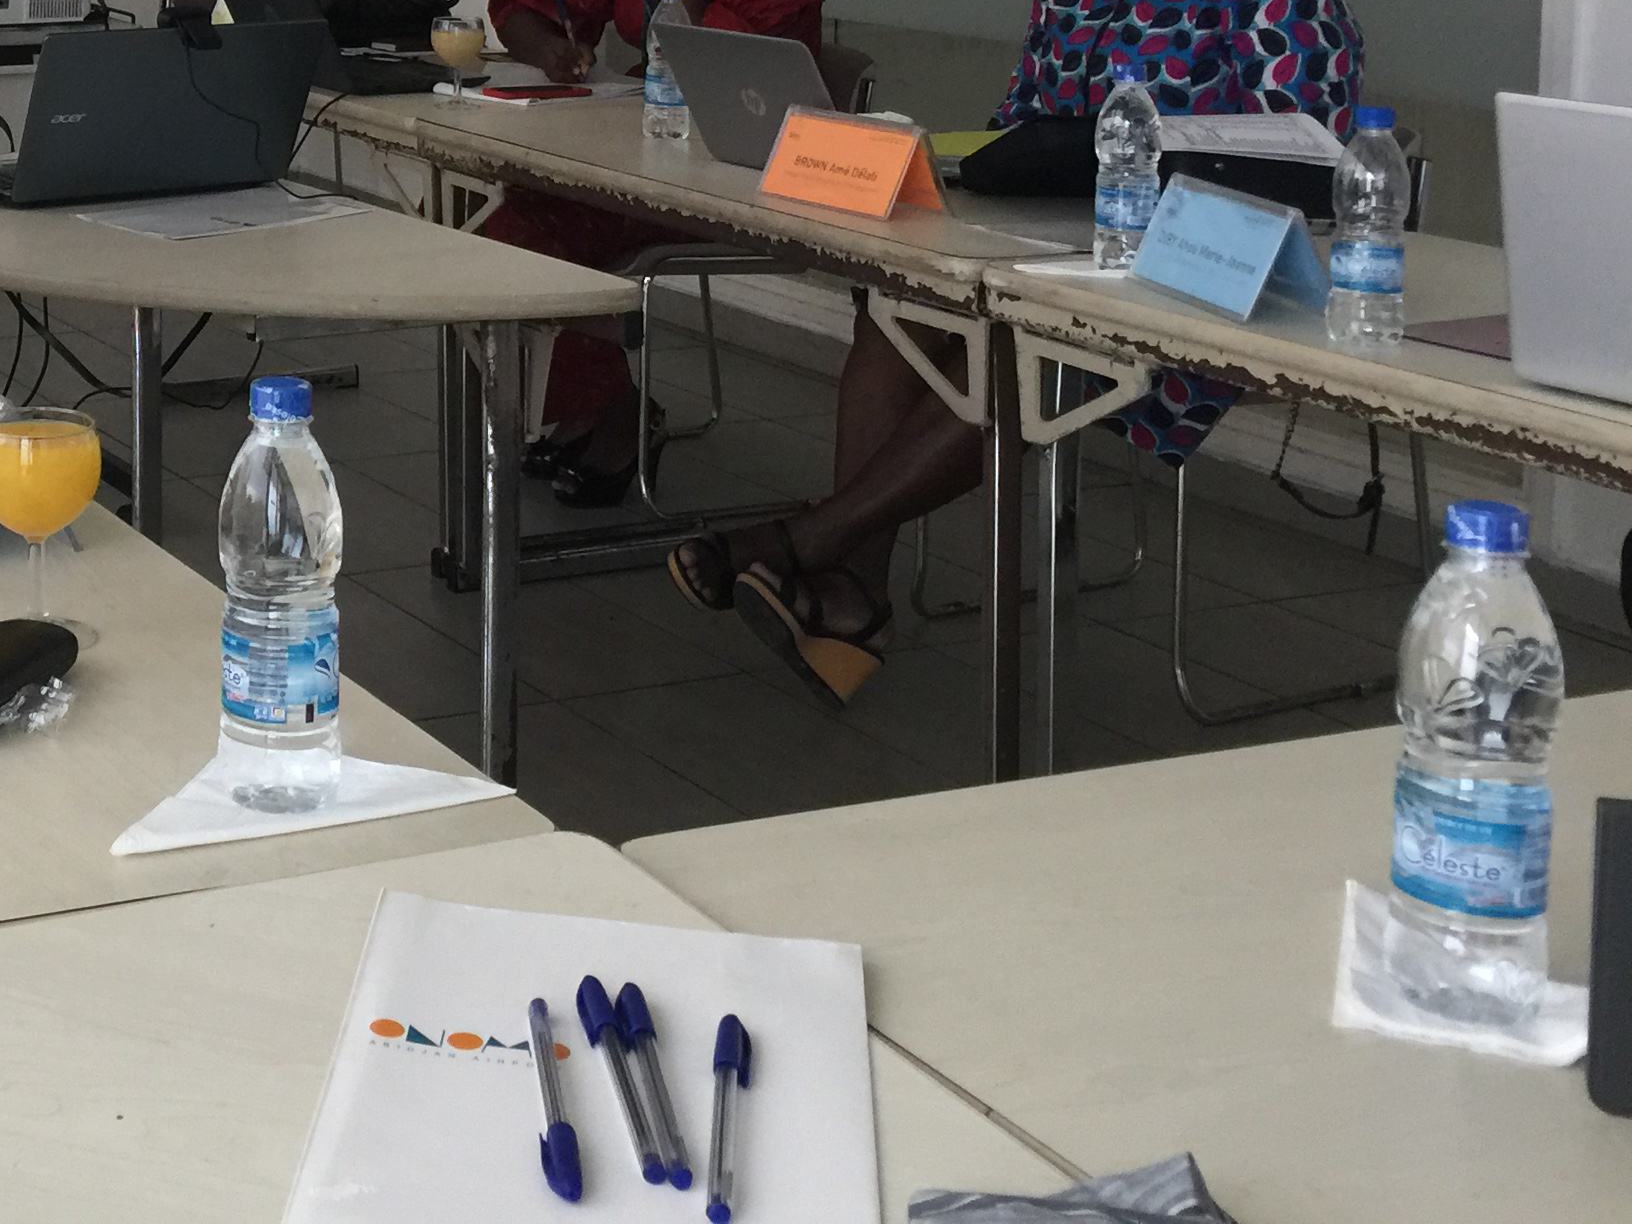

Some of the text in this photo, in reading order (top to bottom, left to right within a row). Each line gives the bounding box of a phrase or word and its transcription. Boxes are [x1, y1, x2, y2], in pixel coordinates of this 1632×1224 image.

[49, 112, 88, 125] acer
[793, 154, 828, 172] BROWN
[1400, 824, 1501, 881] Céleste
[368, 1038, 457, 1059] ABIDJAN
